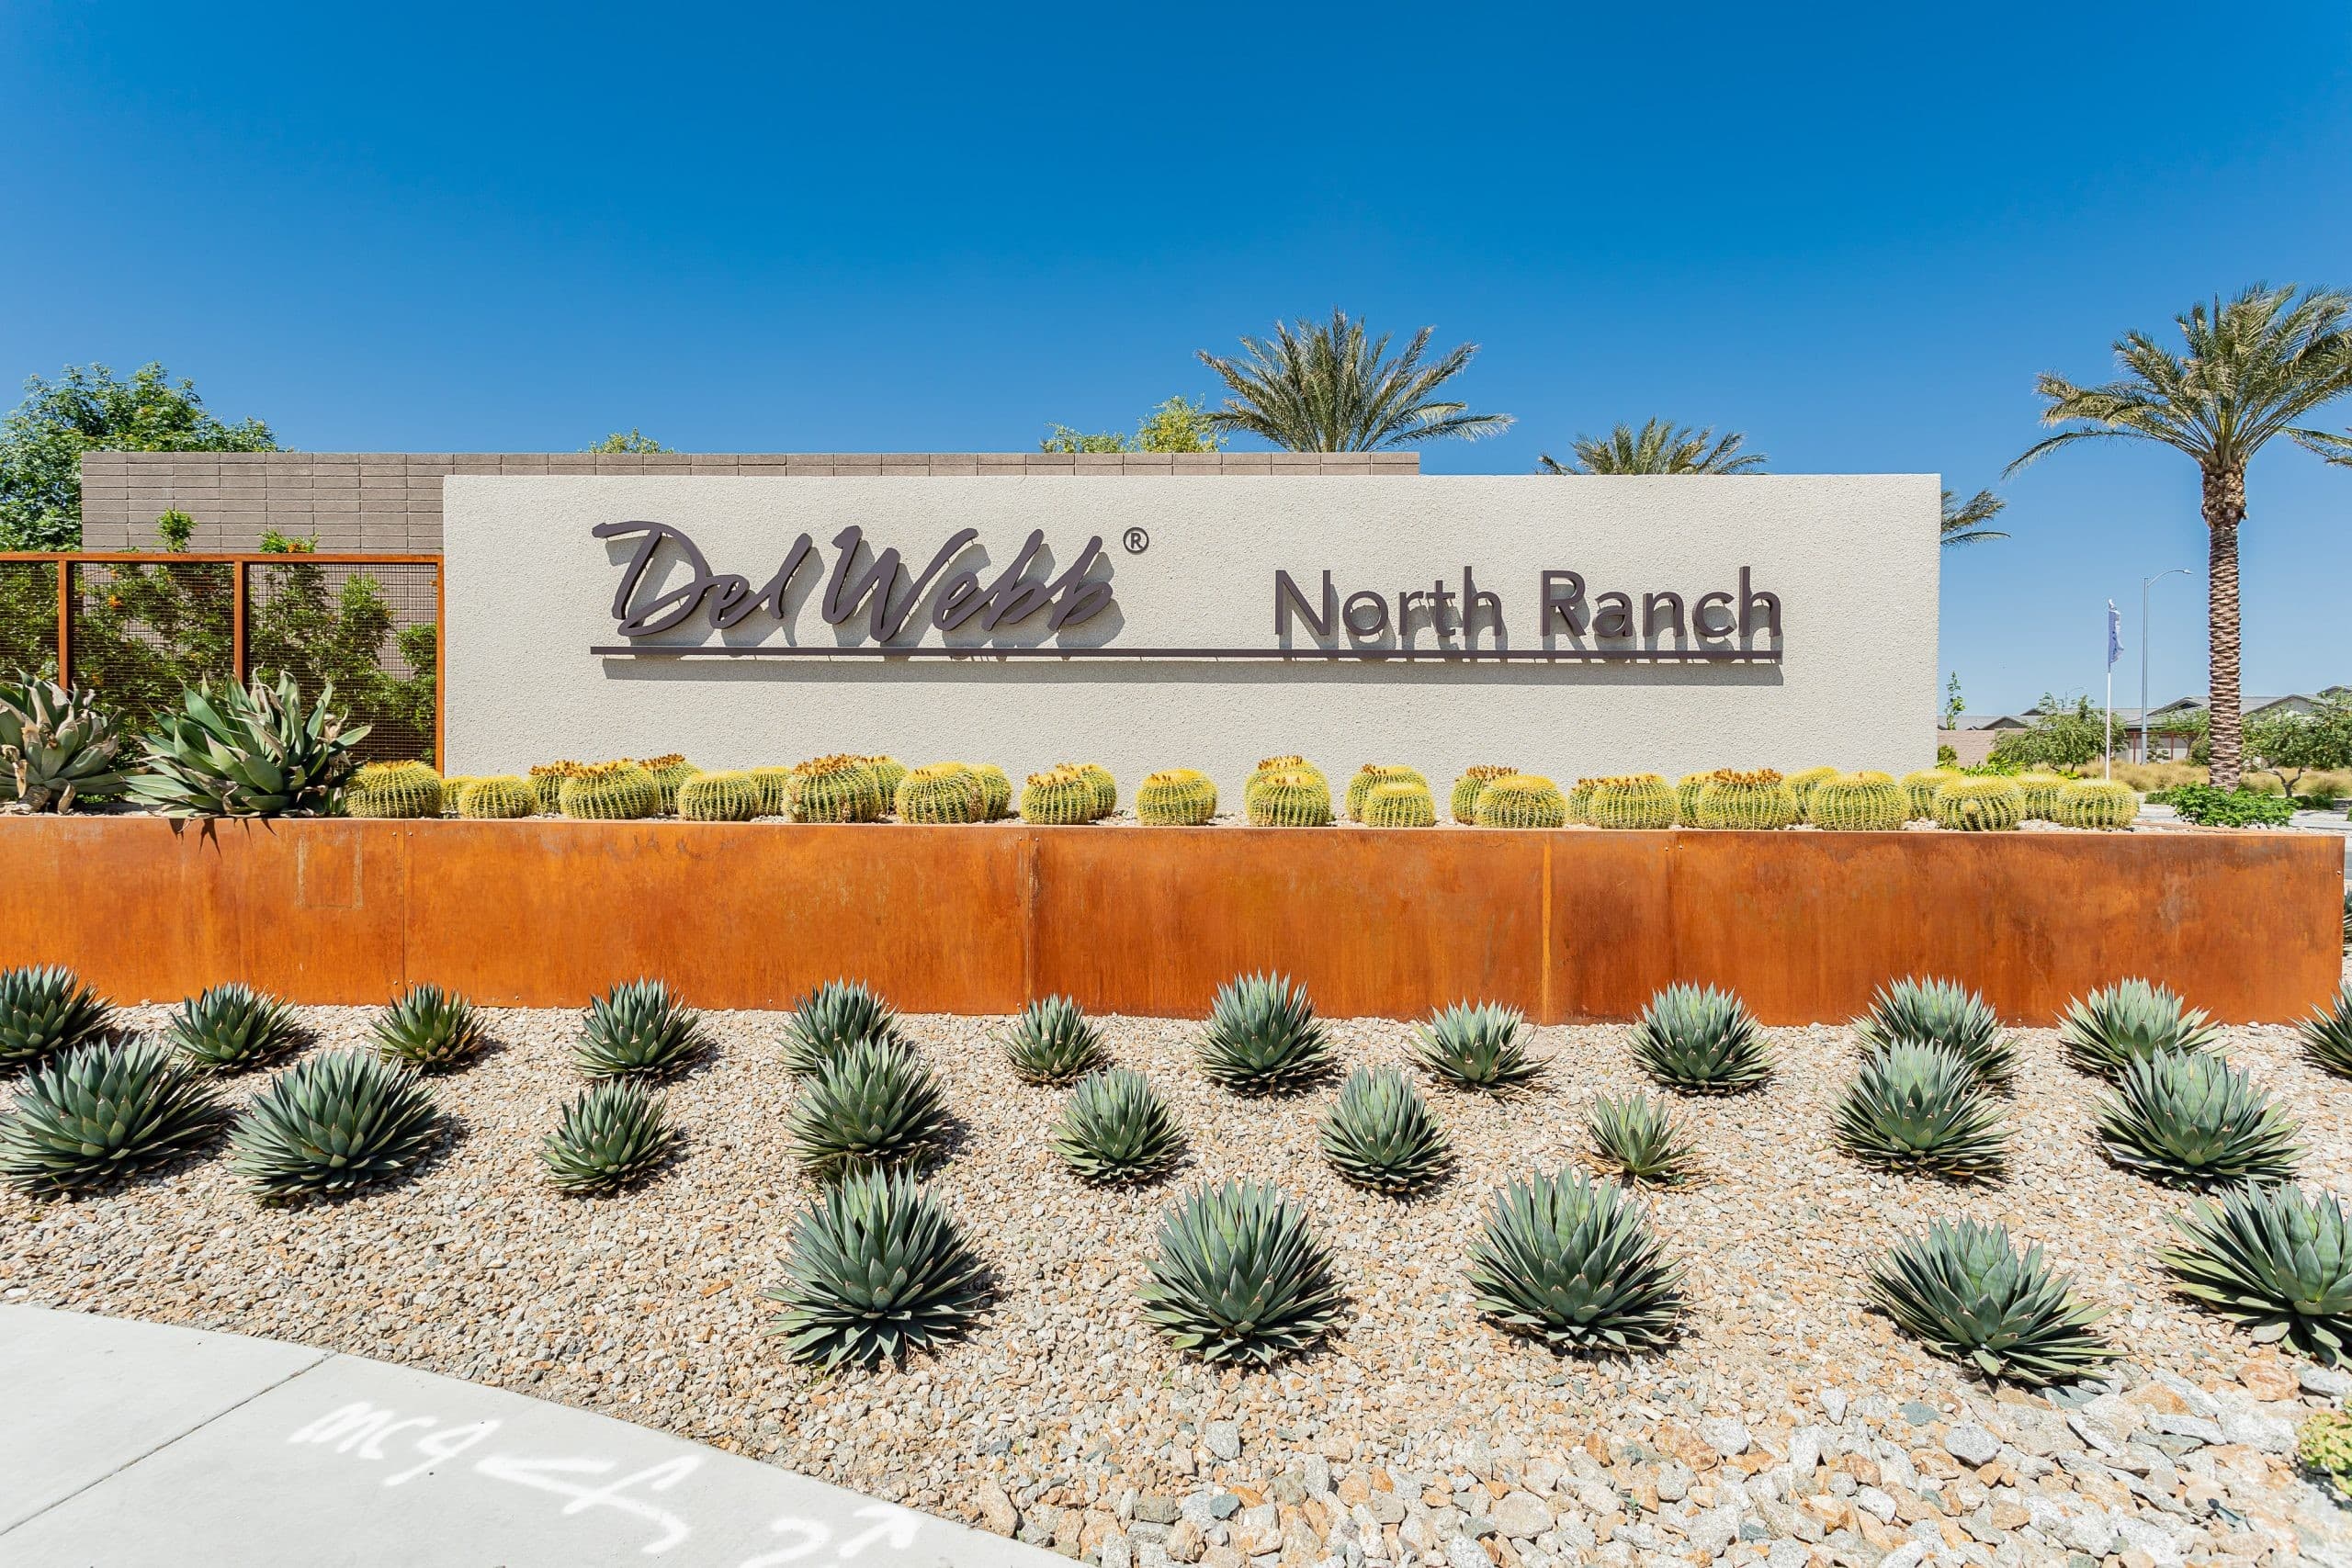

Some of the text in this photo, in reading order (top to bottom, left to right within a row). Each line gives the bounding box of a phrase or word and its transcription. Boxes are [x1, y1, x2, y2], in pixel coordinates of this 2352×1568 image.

[592, 520, 812, 637] Del
[822, 525, 1113, 642] Webb
[1274, 566, 1781, 637] North Ranch
